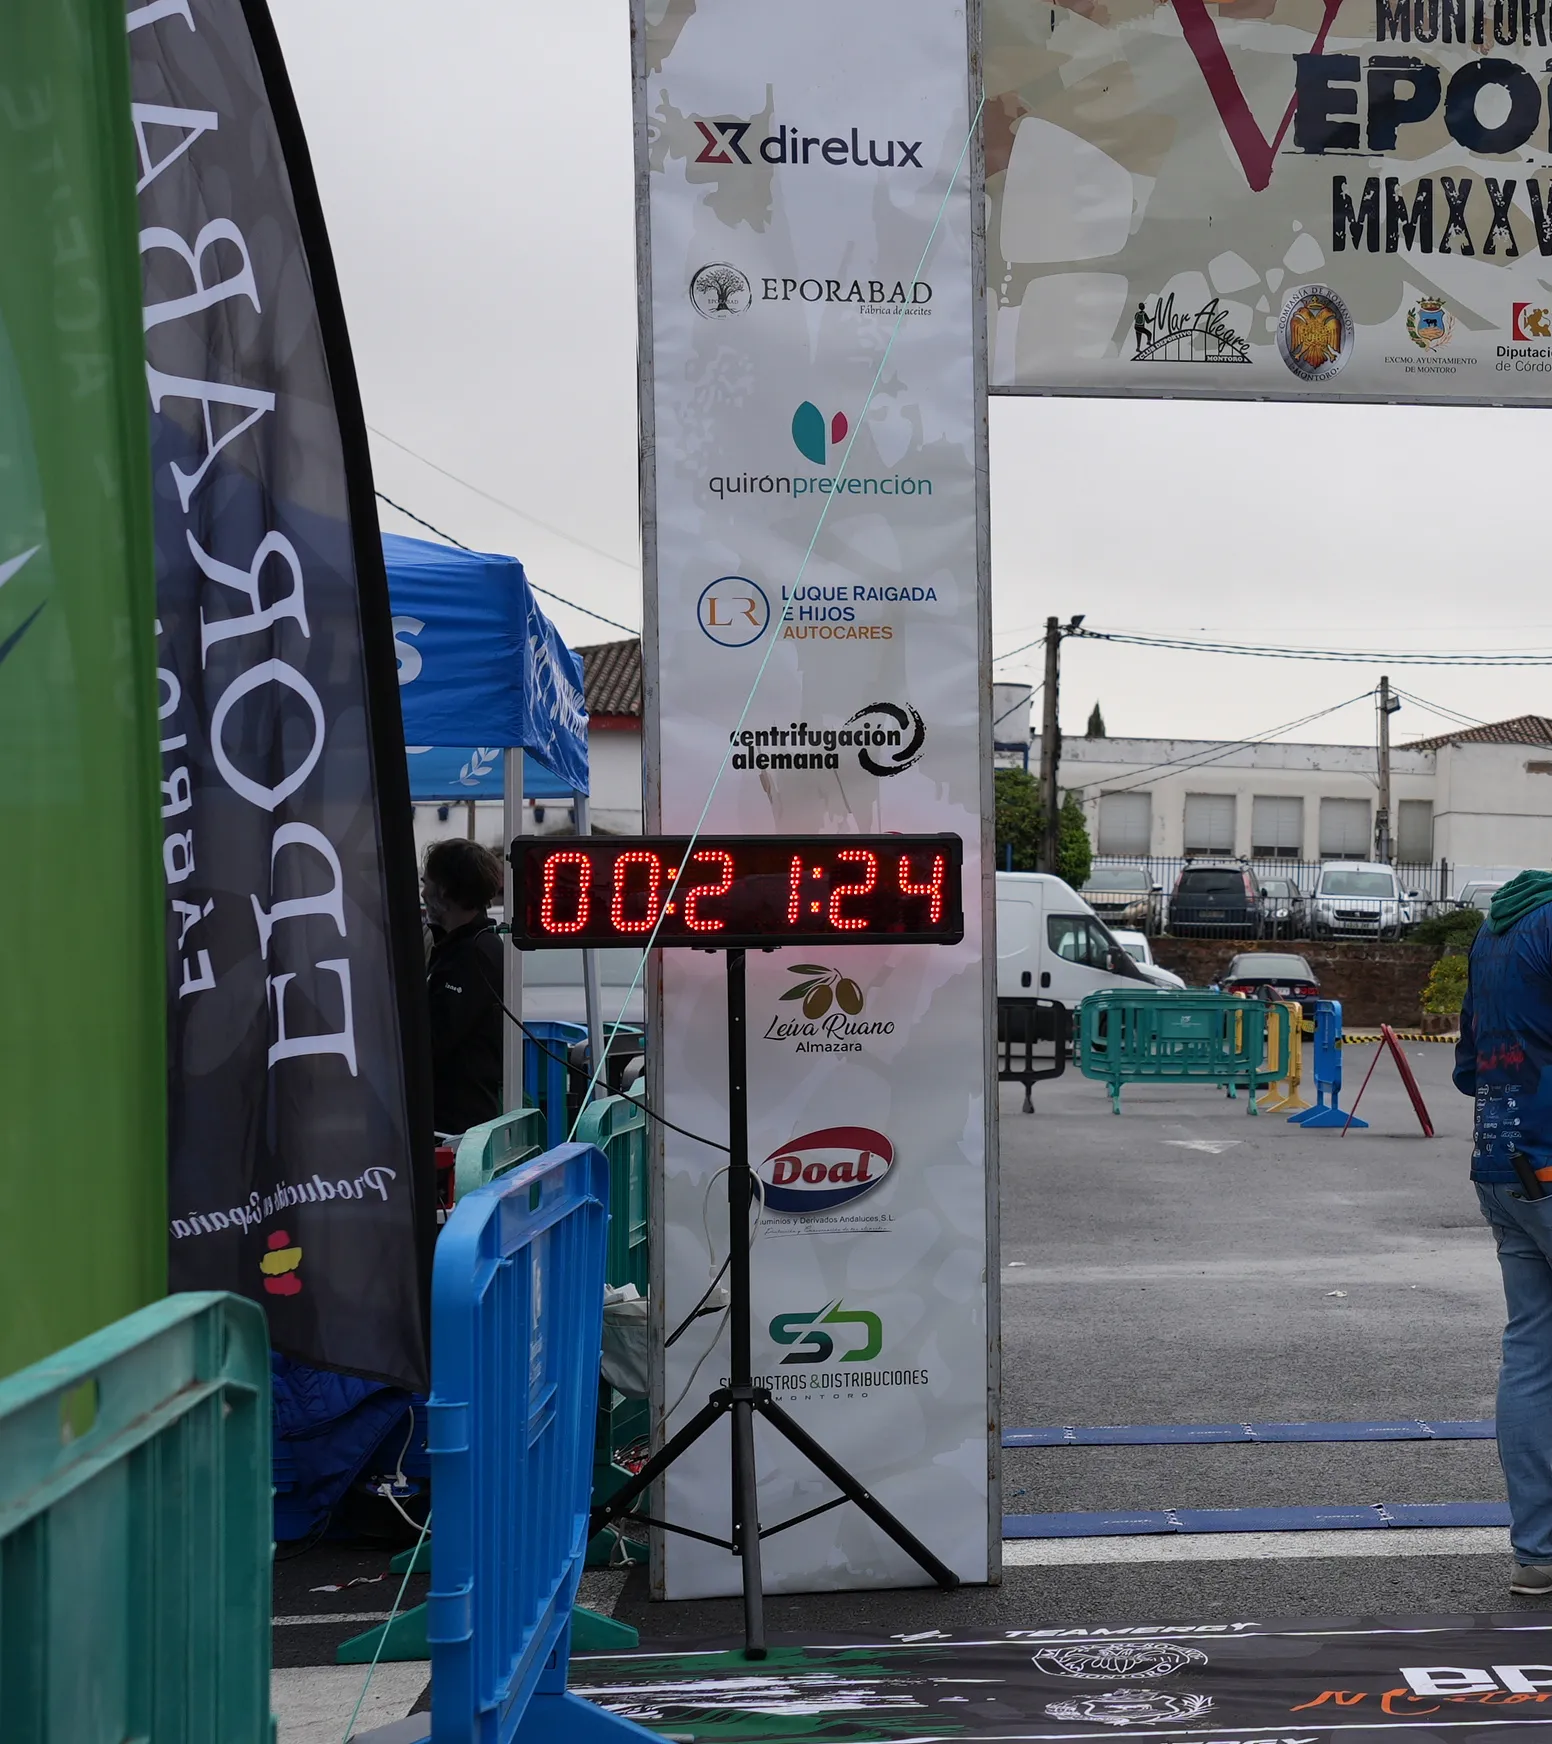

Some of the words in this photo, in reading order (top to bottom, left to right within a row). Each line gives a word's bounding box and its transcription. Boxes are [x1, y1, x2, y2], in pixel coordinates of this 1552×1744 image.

[760, 124, 923, 168] direlux
[761, 277, 933, 304] EPORABAD
[860, 305, 891, 316] Fábrica
[893, 306, 903, 316] de
[904, 308, 932, 316] aceites
[1311, 286, 1324, 295] DE
[1325, 290, 1353, 332] ROMANOS
[1153, 292, 1191, 334] Mar
[1191, 298, 1251, 355] Alegre
[1138, 344, 1156, 361] CLUB
[1155, 330, 1193, 349] DEPORTIVO
[1384, 356, 1415, 365] EXCMO.
[1416, 356, 1478, 365] AYUNTAMIENTO
[1405, 366, 1416, 374] DE
[1418, 366, 1457, 374] MONTORO
[1495, 361, 1512, 372] de
[1293, 367, 1337, 382] MONTORO
[709, 472, 933, 500] quirónprevención
[782, 585, 848, 602] LUQUE
[853, 586, 937, 602] RAIGADA
[707, 597, 760, 627] LR
[783, 606, 794, 621] E
[799, 605, 856, 622] HIJOS
[783, 626, 893, 640] AUTOCARES
[730, 723, 901, 752] centrifugación
[732, 746, 839, 771] alemana
[541, 850, 943, 933] 00:21:24
[822, 1011, 895, 1041] Ruano
[795, 1041, 863, 1054] Almazara
[772, 1151, 874, 1186] Doal
[800, 1217, 838, 1225] Derivados
[775, 1392, 868, 1401] MONTORO
[1004, 1620, 1263, 1639] TEAMERGY
